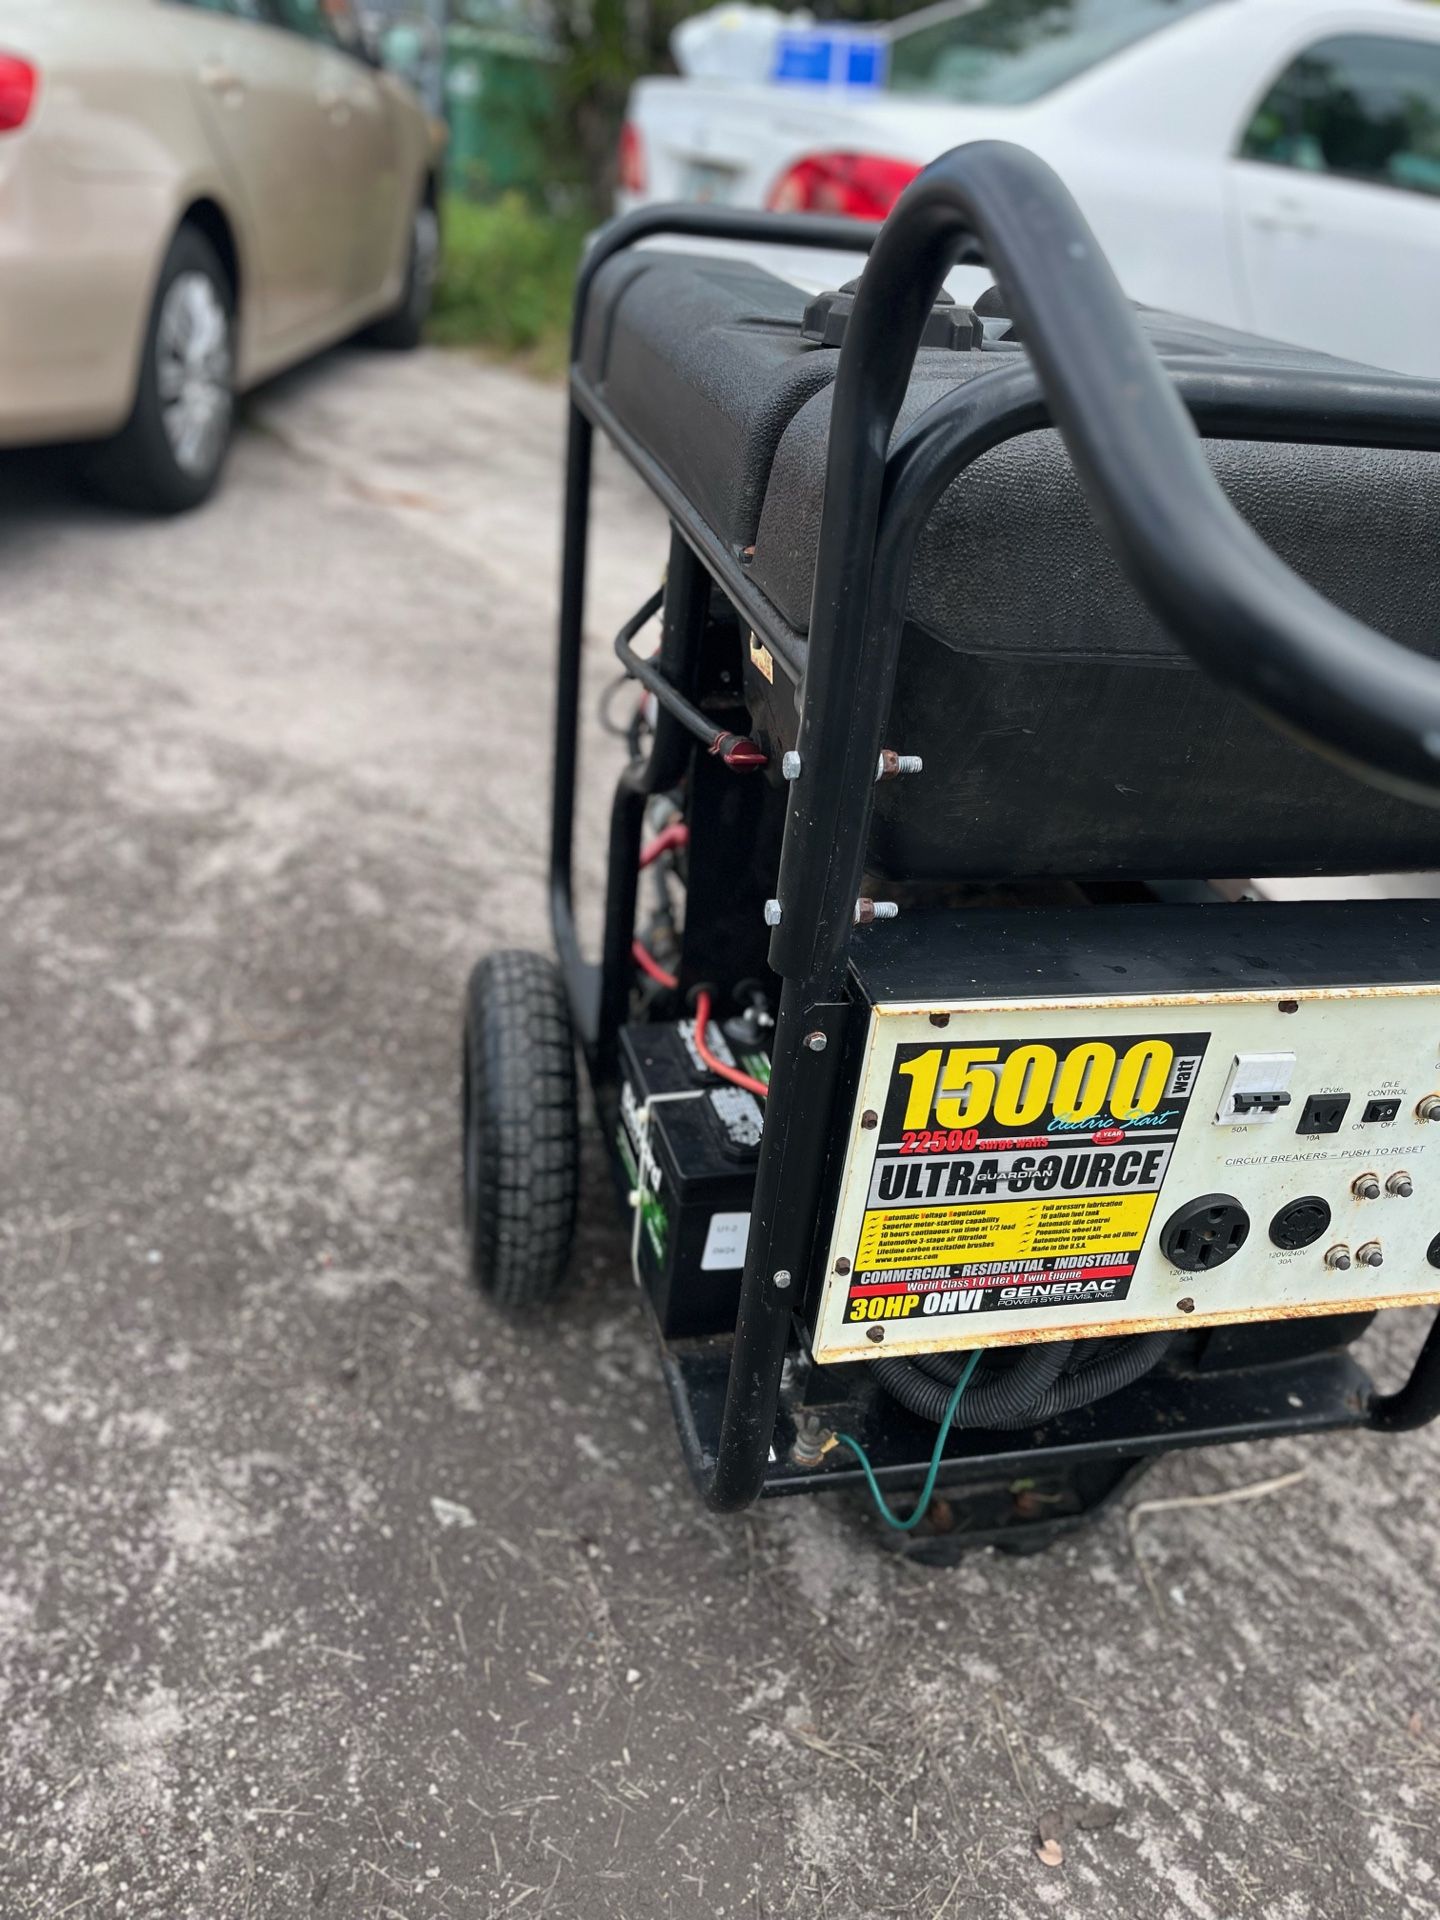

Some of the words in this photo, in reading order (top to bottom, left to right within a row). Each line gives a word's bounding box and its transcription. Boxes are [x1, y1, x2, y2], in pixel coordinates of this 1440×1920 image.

[899, 1040, 1174, 1130] 15000
[1172, 1060, 1195, 1094] watt
[1367, 1089, 1408, 1097] CONTROL
[1120, 1108, 1180, 1129] Start
[1380, 1121, 1398, 1129] OFF
[899, 1129, 979, 1154] 22500
[979, 1138, 1013, 1151] surge
[1015, 1136, 1049, 1148] watts
[1225, 1156, 1267, 1166] CIRCUIT
[1270, 1152, 1328, 1163] BREAKERS
[1341, 1149, 1371, 1158] PUSH
[1375, 1147, 1389, 1155] TO
[1391, 1145, 1426, 1154] RESET
[878, 1159, 999, 1200] ULTRA
[1008, 1150, 1165, 1193] SOURCE
[976, 1170, 1053, 1181] GUARDIAN
[1087, 1201, 1123, 1209] lubrication
[883, 1213, 919, 1221] Automatic
[948, 1209, 986, 1218] Regulation
[913, 1219, 964, 1228] motor-starting
[965, 1217, 1000, 1225] capability
[889, 1230, 909, 1238] hours
[911, 1228, 949, 1236] continuous
[1033, 1236, 1070, 1244] Automotive
[878, 1239, 918, 1247] Automotive
[875, 1254, 938, 1263] www.generac.com
[860, 1266, 951, 1284] COMMERCIAL
[962, 1259, 1043, 1276] RESIDENTIAL
[1054, 1252, 1129, 1269] INDUSTRIAL
[907, 1281, 938, 1291] World
[941, 1279, 968, 1289] Class
[987, 1275, 1010, 1286] Liter
[1049, 1270, 1082, 1282] Engine
[1000, 1280, 1116, 1298] GENERAC
[998, 1298, 1038, 1306] POWER
[1095, 1290, 1115, 1298] INC.
[850, 1294, 919, 1321] 30HP
